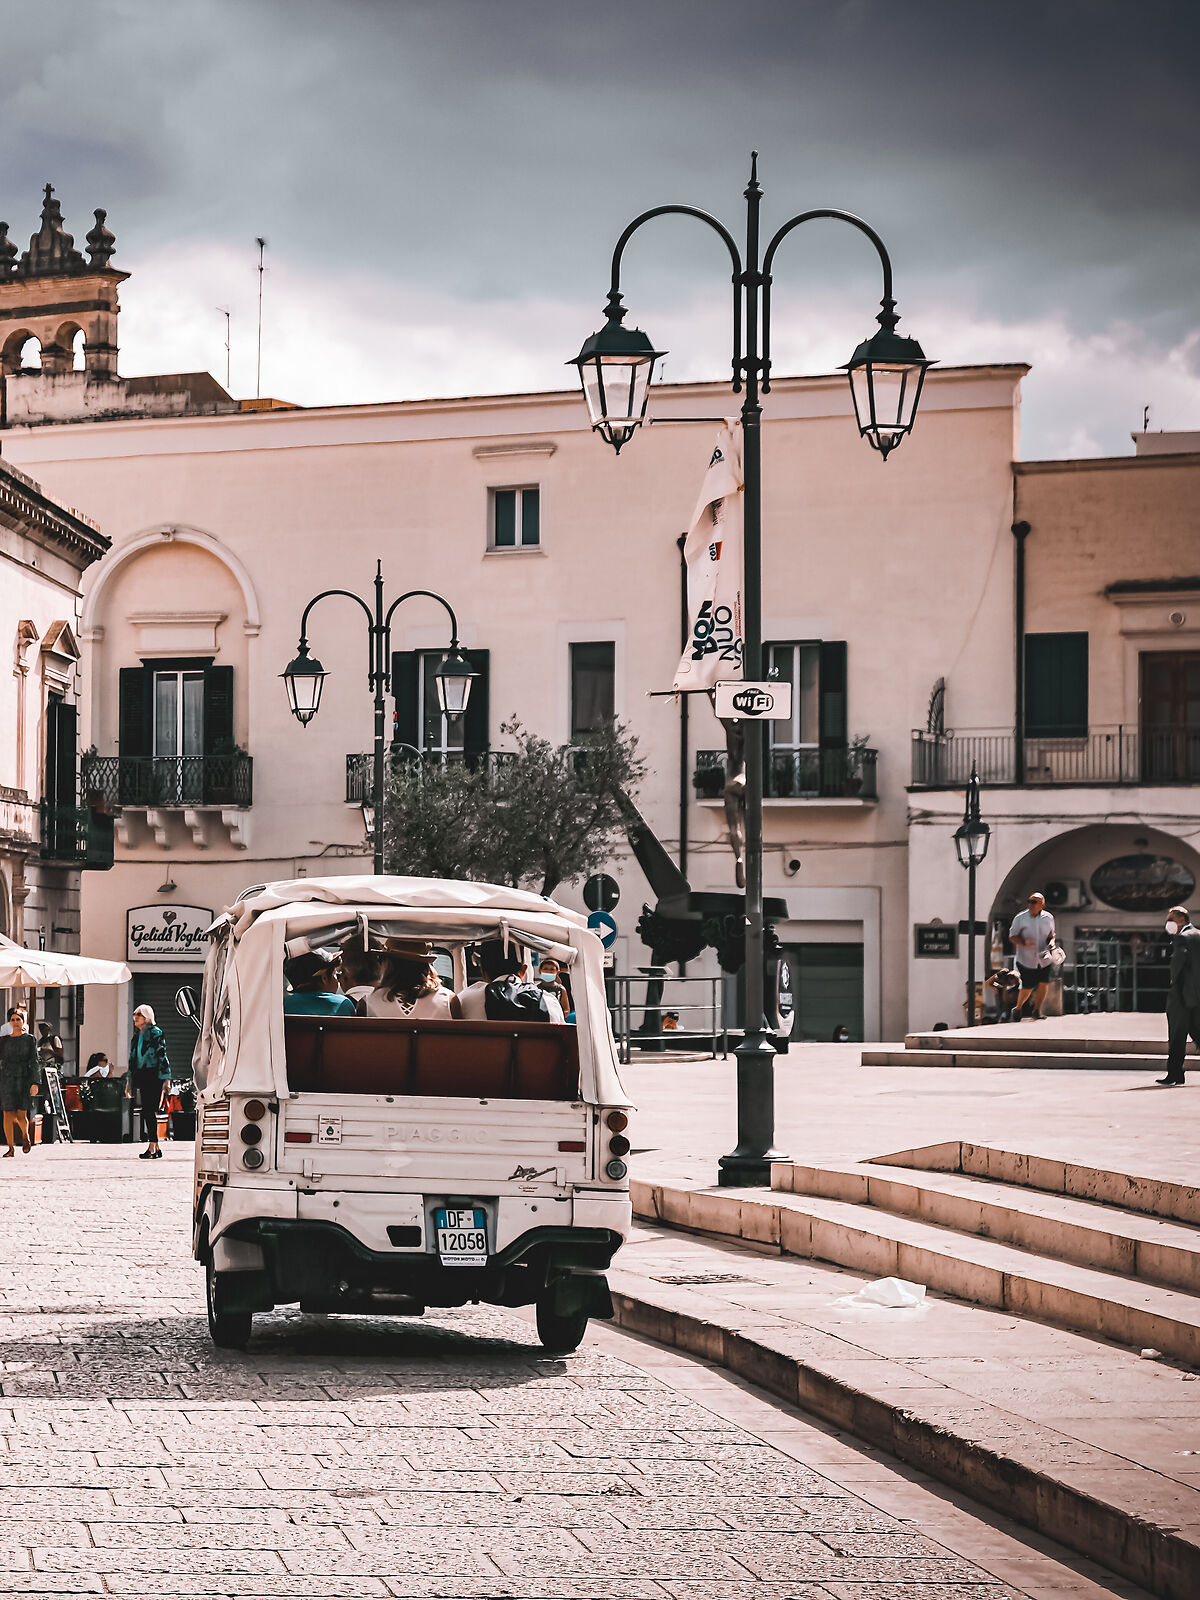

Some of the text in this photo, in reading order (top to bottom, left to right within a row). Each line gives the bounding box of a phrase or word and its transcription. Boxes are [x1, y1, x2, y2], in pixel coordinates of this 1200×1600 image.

[692, 600, 713, 661] MON
[714, 605, 735, 661] NUO
[130, 922, 209, 947] Gelida Voglia
[447, 1210, 465, 1228] DF
[441, 1232, 485, 1251] 12058
